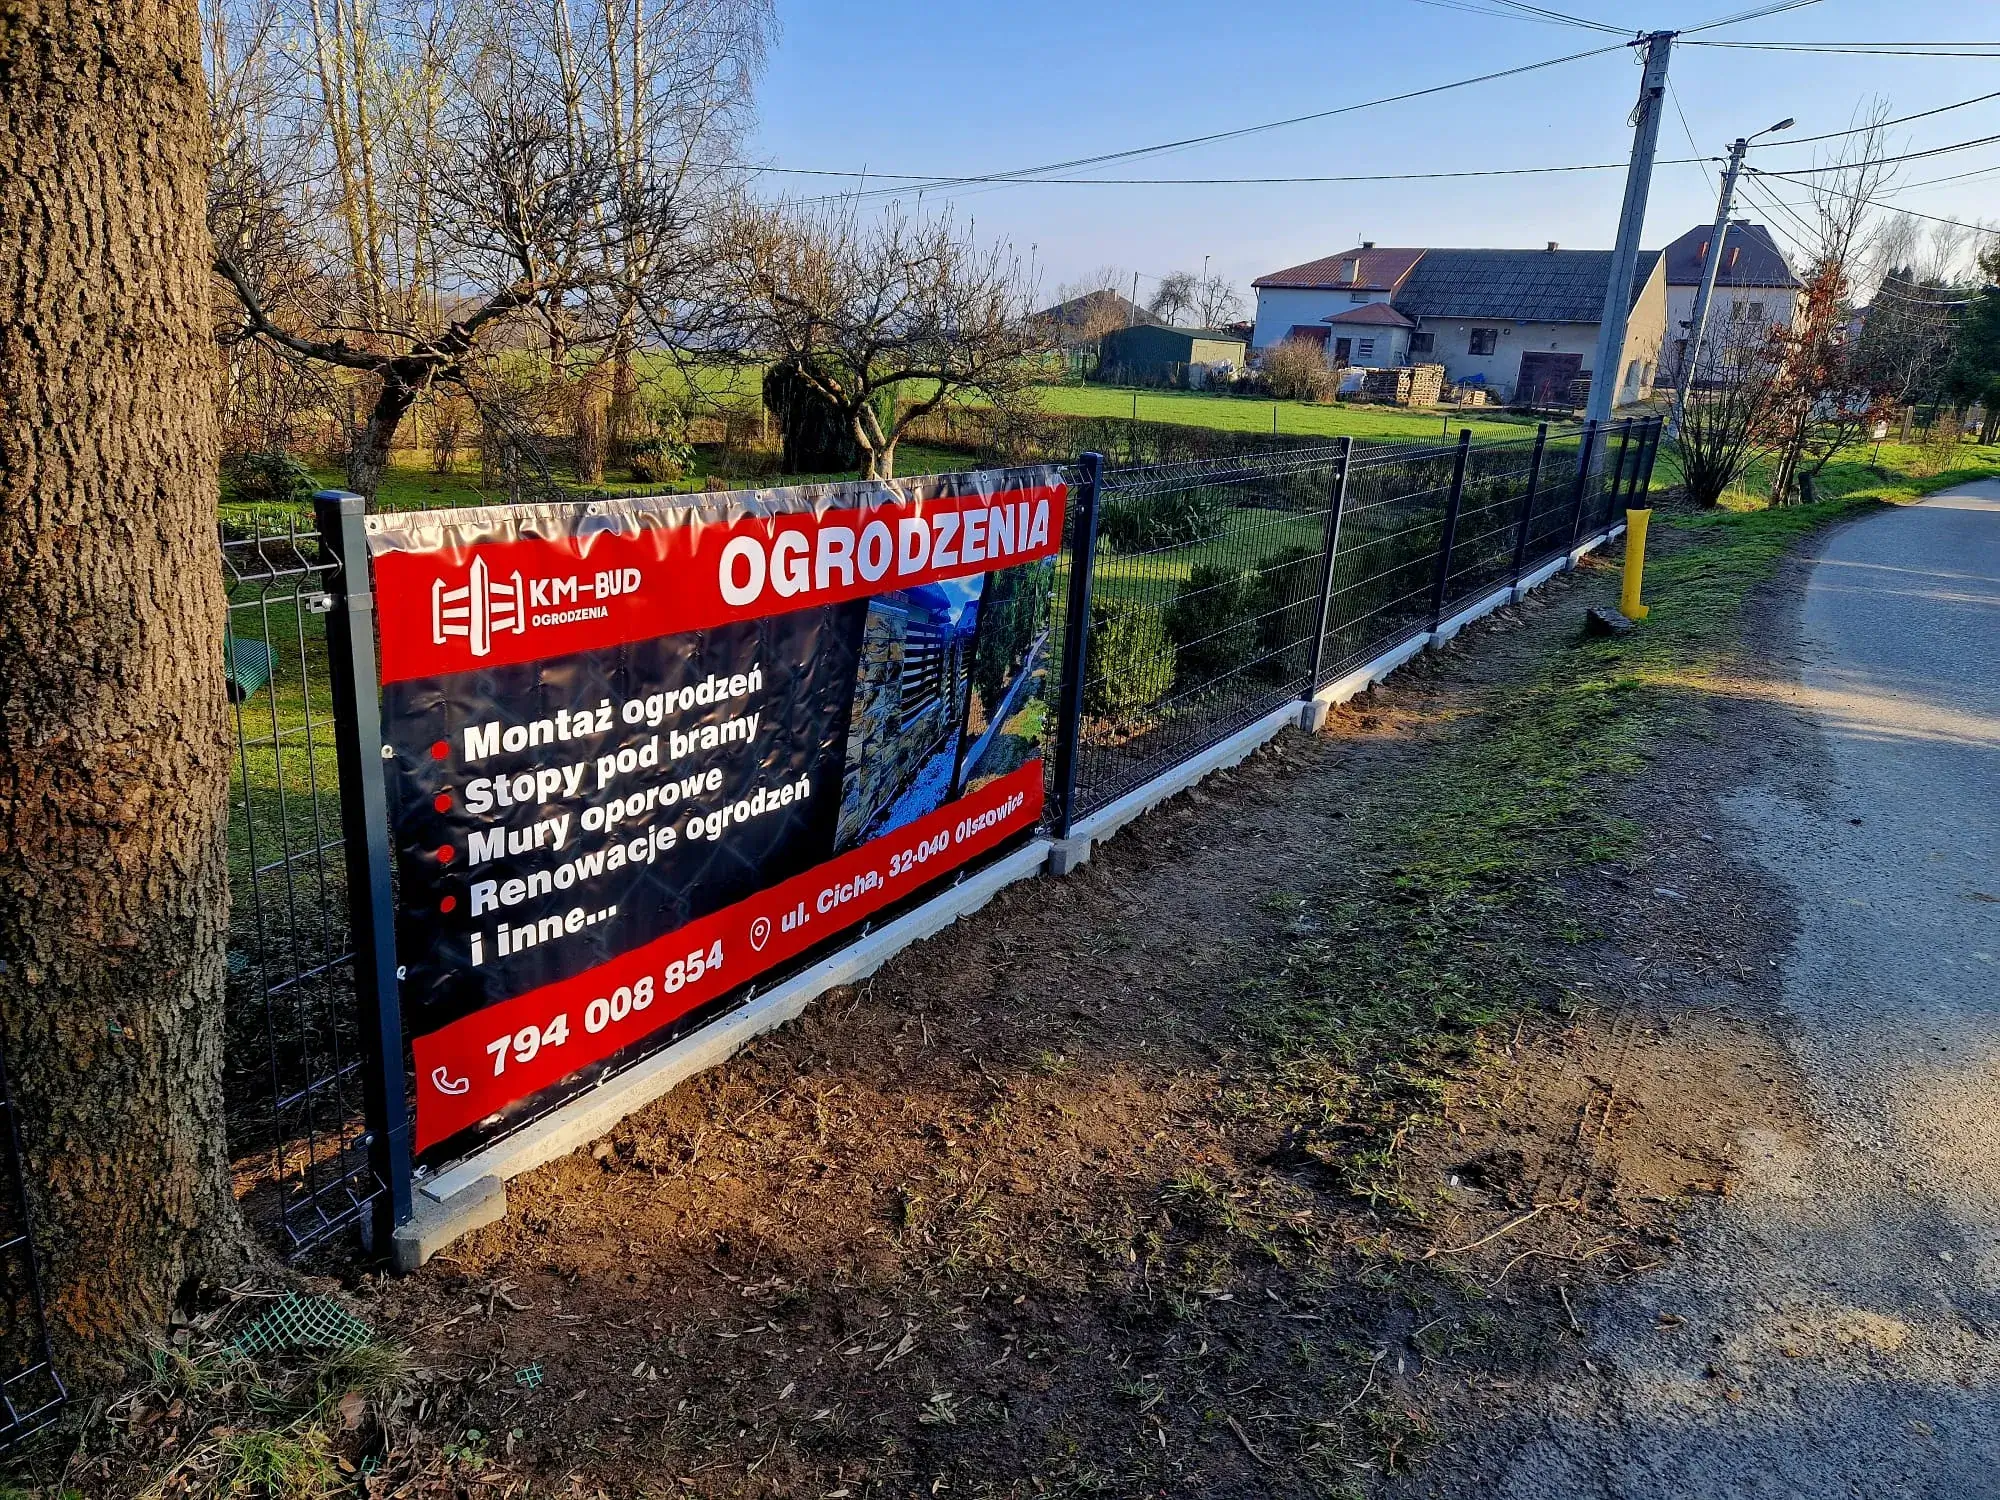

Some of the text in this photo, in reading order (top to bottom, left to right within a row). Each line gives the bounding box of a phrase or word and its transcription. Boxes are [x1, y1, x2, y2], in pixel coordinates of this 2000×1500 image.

[530, 568, 642, 607] KM-BUD
[719, 499, 1050, 606] OGRODZENIA
[532, 605, 608, 627] OGRODZENIA
[463, 661, 763, 762] Montaż ogrodzeń
[465, 711, 760, 815] Stopy pod bramy
[467, 769, 723, 867] Mury oporowe
[469, 774, 811, 917] Renowacje ogrodzeń
[781, 790, 1024, 933] ul. Cicha, 32-040 Olszowice
[470, 903, 617, 967] i inne...
[486, 939, 725, 1077] 794 008 854
